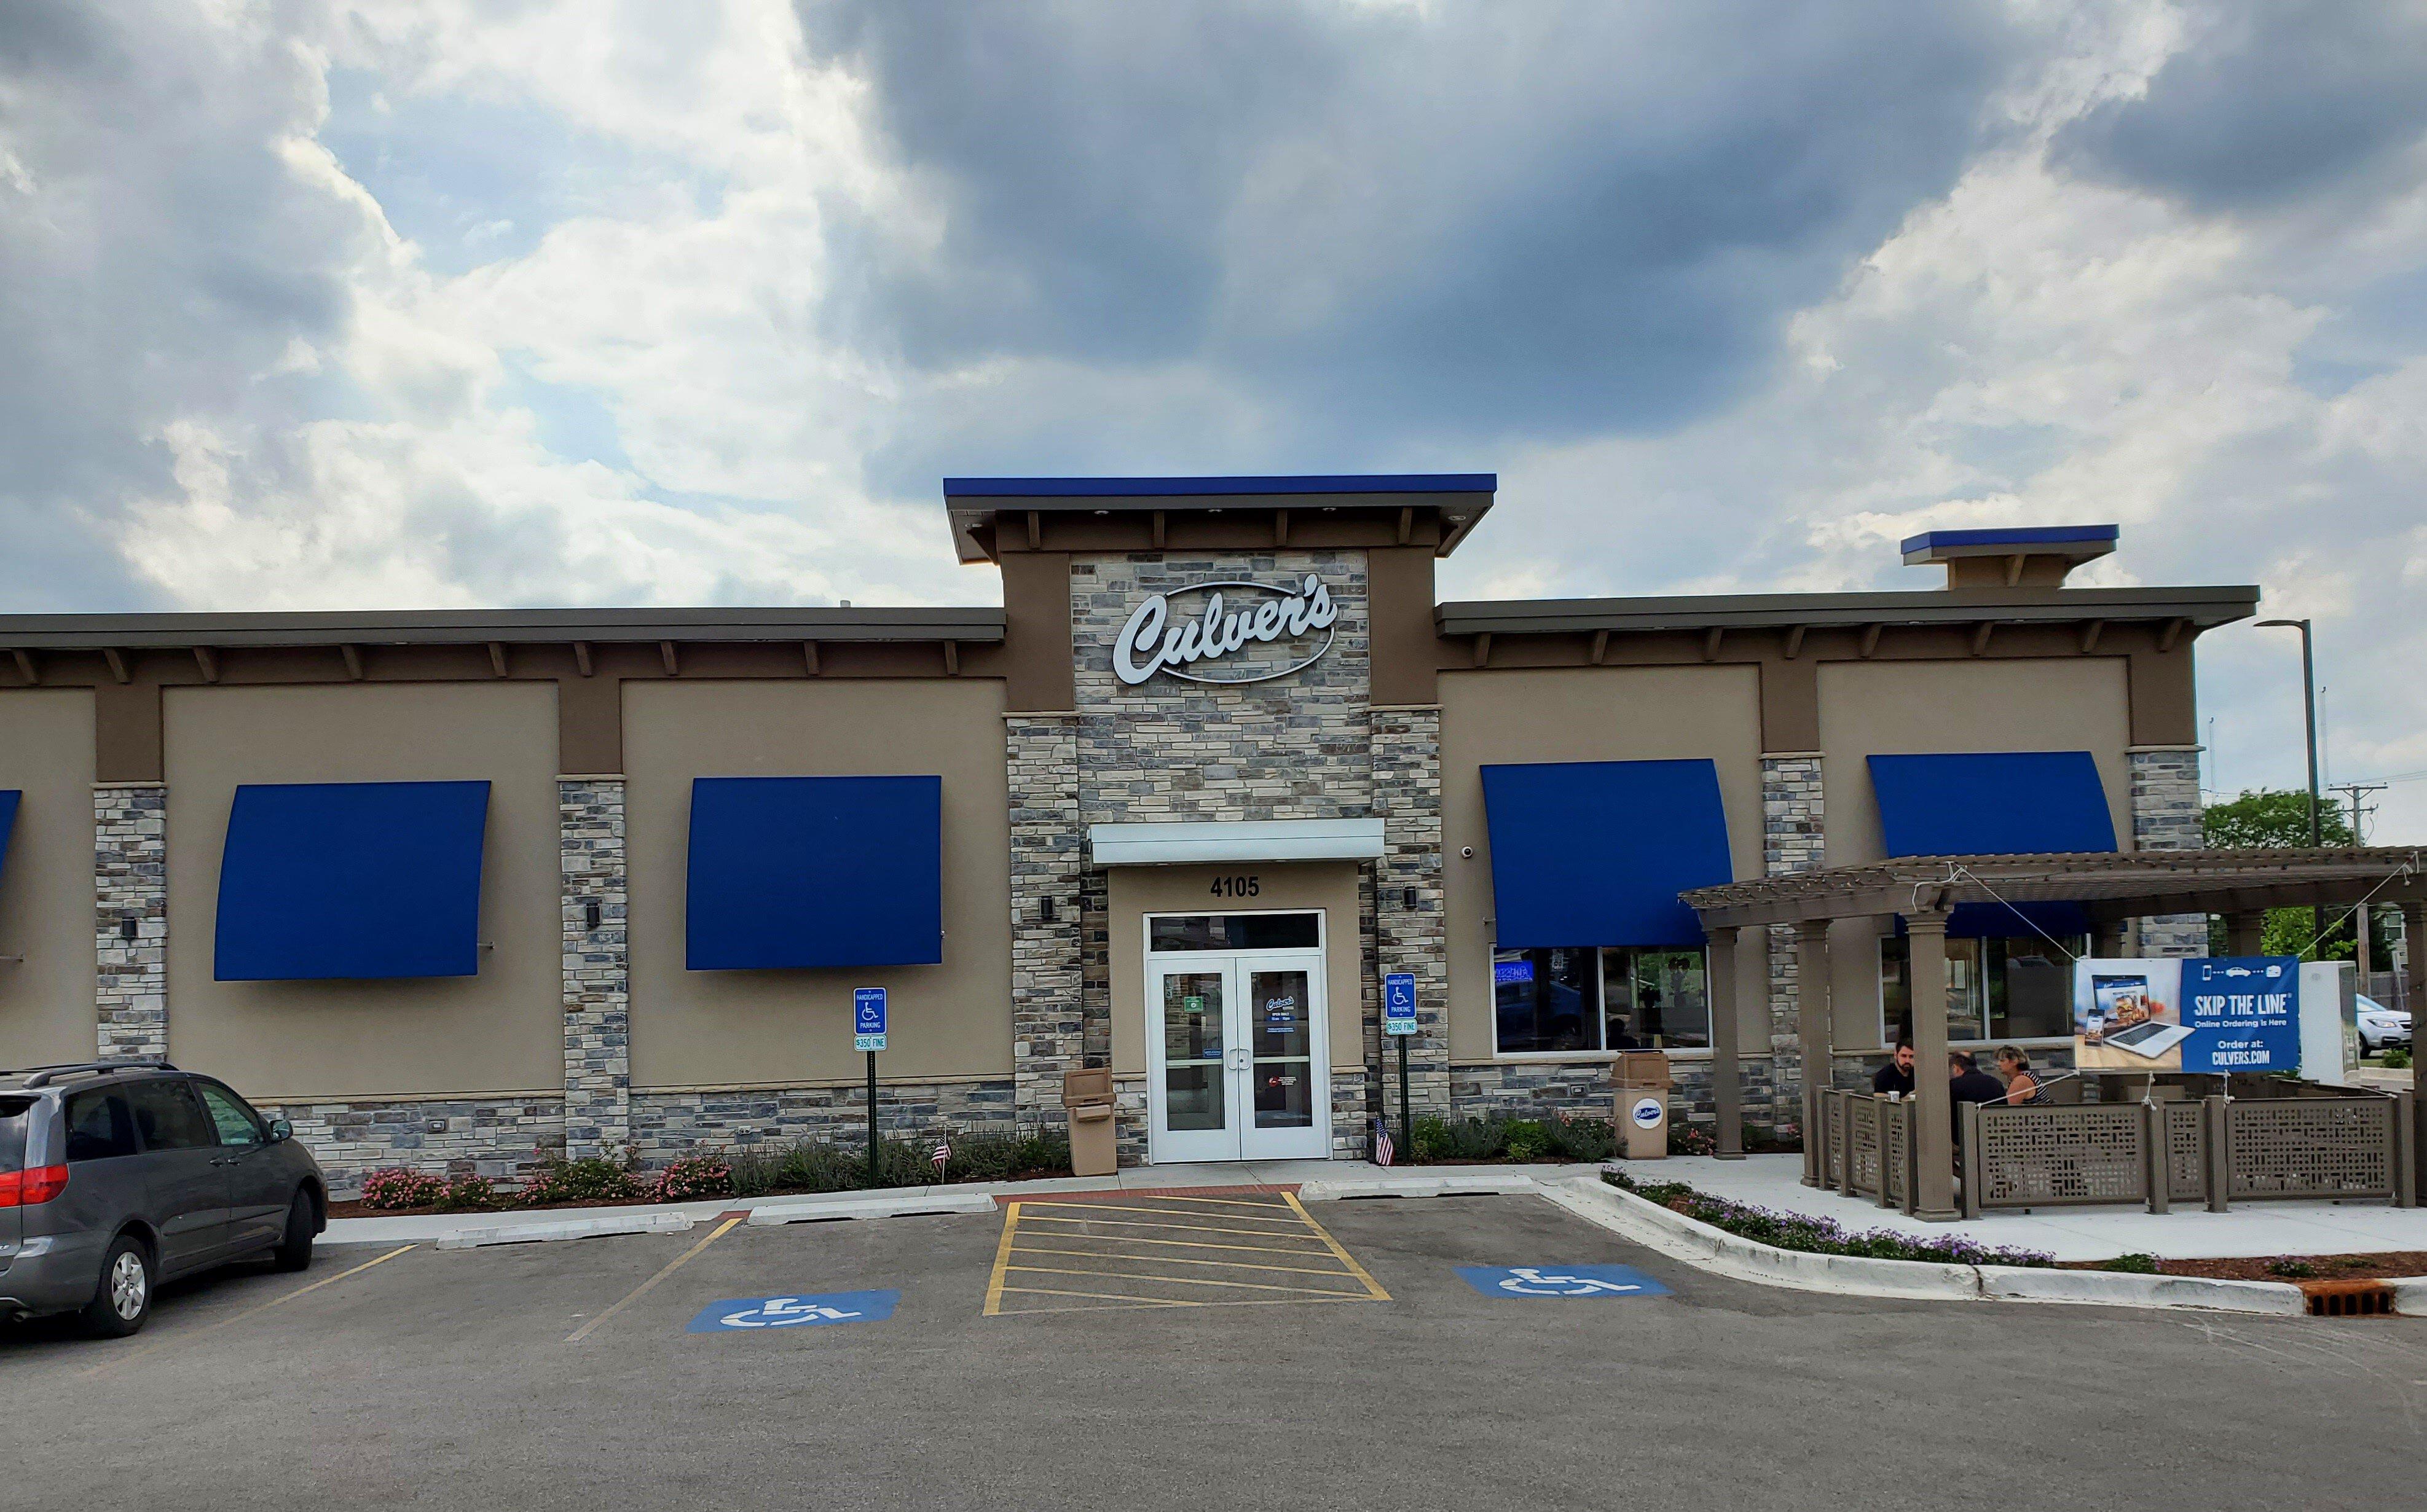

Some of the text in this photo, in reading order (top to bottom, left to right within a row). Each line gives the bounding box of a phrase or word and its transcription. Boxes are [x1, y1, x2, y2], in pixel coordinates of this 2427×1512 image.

[1112, 573, 1339, 684] Culver's
[1210, 876, 1259, 897] 4105
[2193, 995, 2225, 1016] SKIP
[2228, 995, 2254, 1016] THE
[856, 1038, 884, 1047] $350 FINE
[2218, 1040, 2264, 1049] Order at:
[2212, 1050, 2270, 1066] CULVERS.COM
